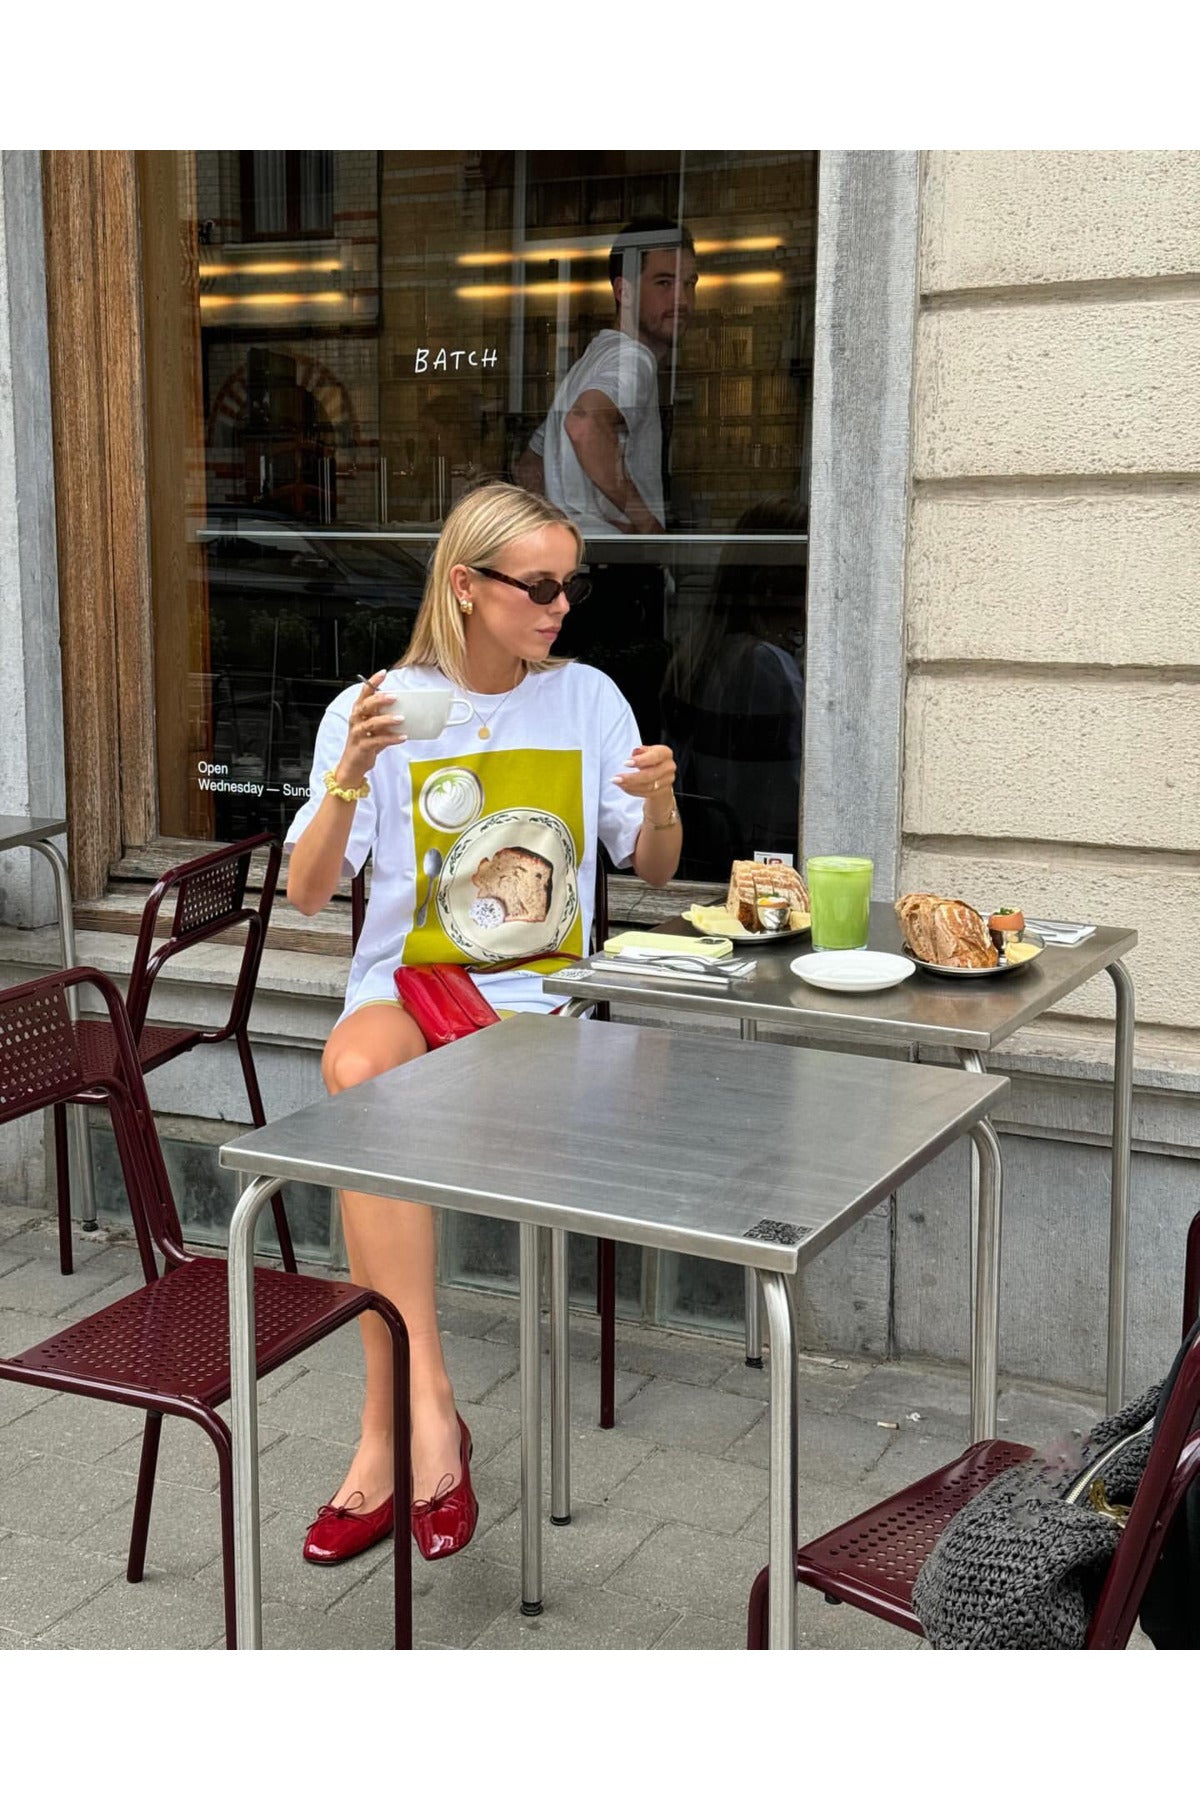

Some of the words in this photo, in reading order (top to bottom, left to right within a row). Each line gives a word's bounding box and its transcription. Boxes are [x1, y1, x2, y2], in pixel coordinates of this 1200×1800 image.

[414, 348, 498, 374] BATCH
[197, 760, 229, 776] Open
[198, 778, 264, 797] Wednesday
